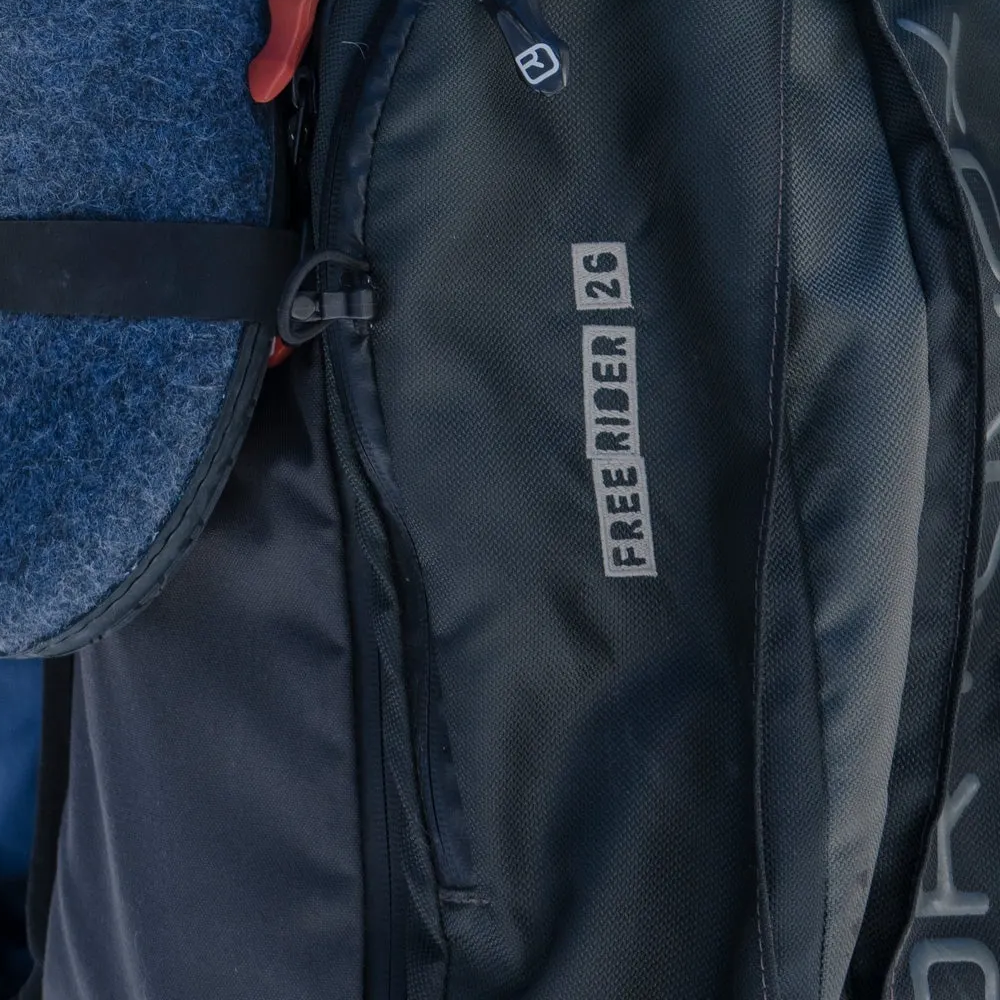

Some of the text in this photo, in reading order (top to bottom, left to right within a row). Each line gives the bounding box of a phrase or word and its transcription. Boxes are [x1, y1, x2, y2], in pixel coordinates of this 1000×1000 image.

[582, 251, 646, 567] FREE RIDER 26
